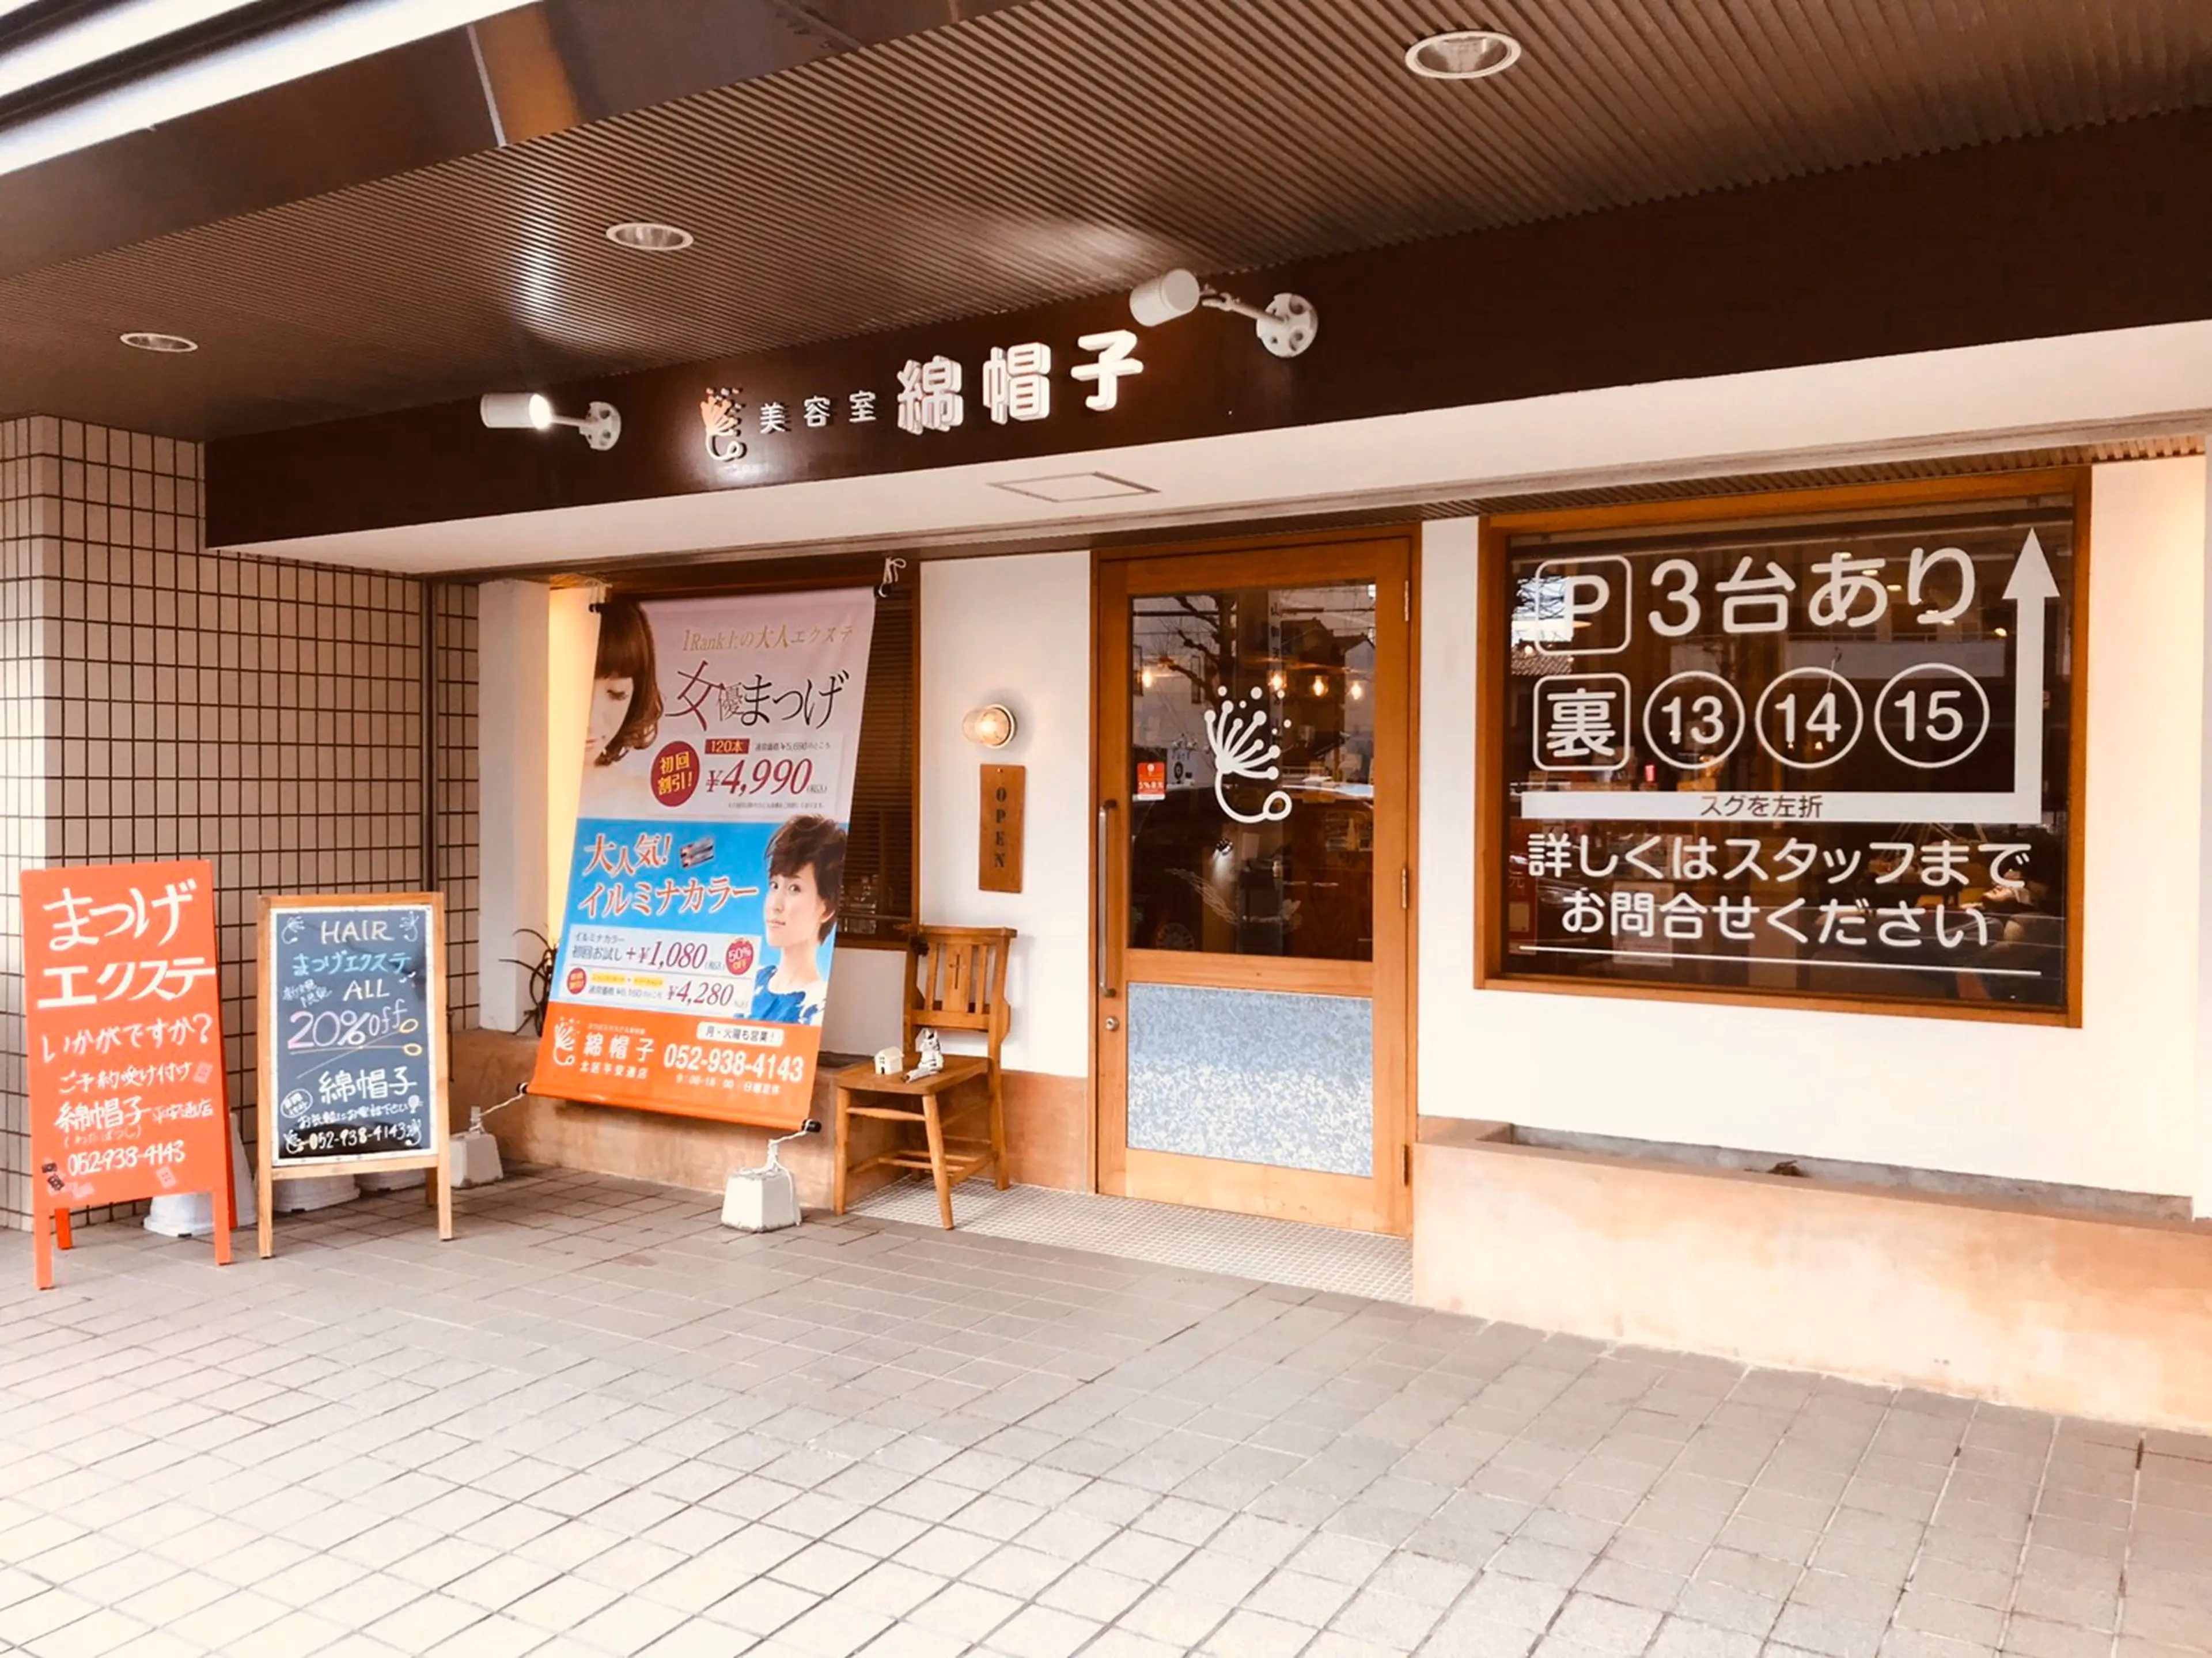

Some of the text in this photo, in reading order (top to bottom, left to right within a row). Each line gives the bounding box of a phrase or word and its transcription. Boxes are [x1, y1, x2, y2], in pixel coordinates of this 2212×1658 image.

[760, 329, 1144, 435] 美容室 綿帽子
[1563, 547, 1976, 642] P 3台あり
[665, 660, 850, 731] 女優まつげ
[1546, 688, 1964, 758] 裏 13 14 15
[660, 752, 691, 773] 初回
[710, 739, 745, 753] 120本
[706, 759, 813, 796] ¥4,990
[1700, 795, 1823, 819] スグを左折
[995, 787, 1007, 868] OPEN
[583, 832, 673, 878] 大人気!
[1527, 832, 2032, 889] 詳しくはスタッフまで
[43, 878, 198, 951] まつげ
[578, 877, 759, 918] イルミナカラー
[321, 920, 395, 945] HAIR
[1562, 890, 1988, 949] お問合せください
[292, 949, 412, 976] まつげエクステ
[573, 944, 623, 961] 初回お試し
[37, 957, 217, 1009] エクステ
[342, 978, 390, 1001] ALL
[668, 981, 734, 1007] ¥4,280
[41, 1013, 213, 1064] いかがですか?
[584, 1032, 654, 1063] 綿帽子
[664, 1043, 805, 1083] 052-938-4143
[319, 1066, 418, 1105] 綿帽子
[54, 1095, 151, 1133] 綿帽子
[308, 1121, 406, 1151] 052-938-4143
[67, 1139, 186, 1177] 052-938-4143
